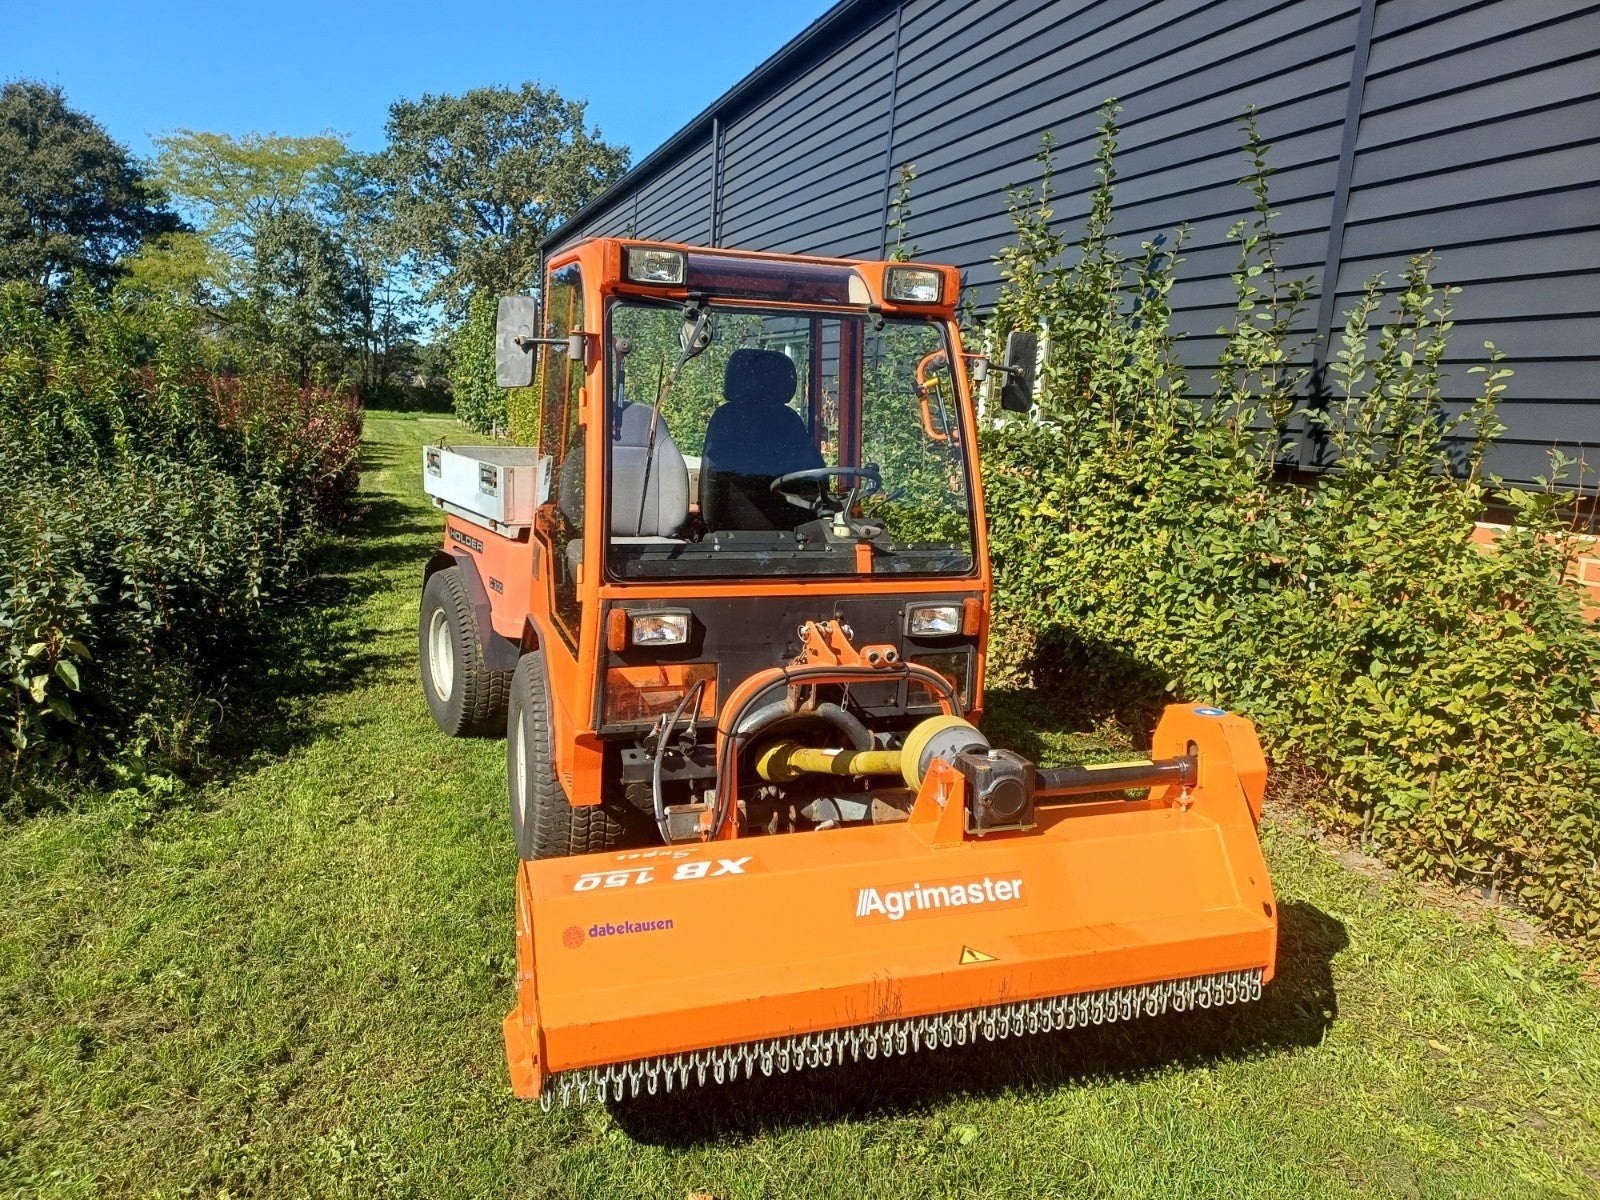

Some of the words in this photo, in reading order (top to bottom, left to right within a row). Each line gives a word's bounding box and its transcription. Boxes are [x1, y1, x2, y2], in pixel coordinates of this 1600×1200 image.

[450, 528, 483, 552] HOLDER
[573, 867, 655, 892] 150
[673, 856, 753, 880] XB
[857, 877, 1022, 920] Agrimaster
[588, 919, 674, 938] dabekausen
